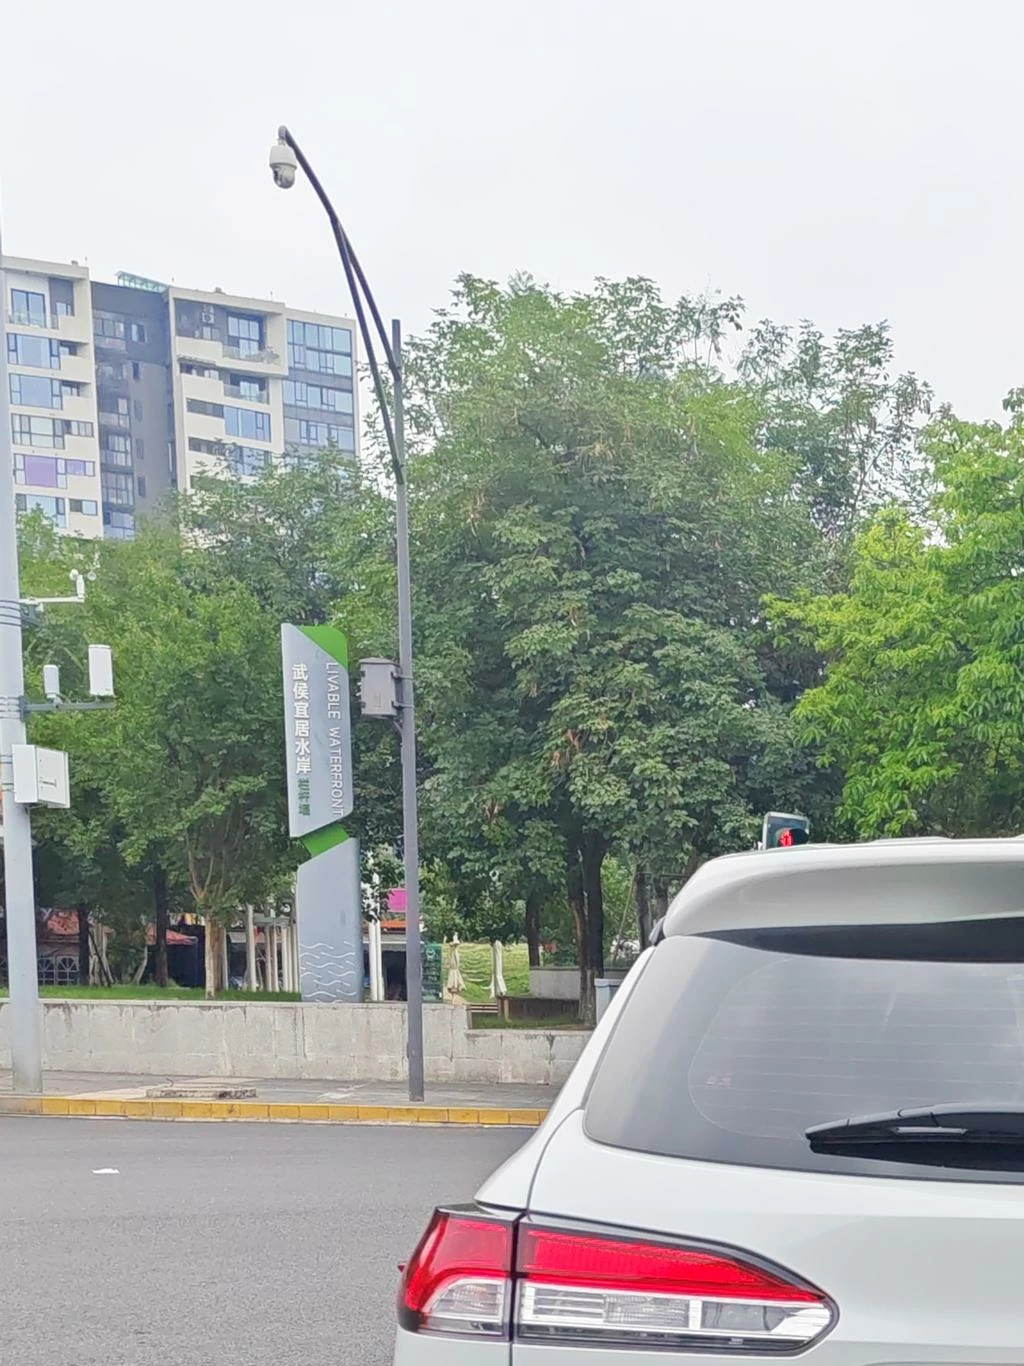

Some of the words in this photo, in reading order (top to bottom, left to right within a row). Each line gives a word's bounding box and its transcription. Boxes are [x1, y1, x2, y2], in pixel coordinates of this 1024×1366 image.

[291, 663, 312, 774] 武侯宜居水岸
[325, 661, 341, 720] LIVABLE
[328, 726, 344, 817] WATERFRONT
